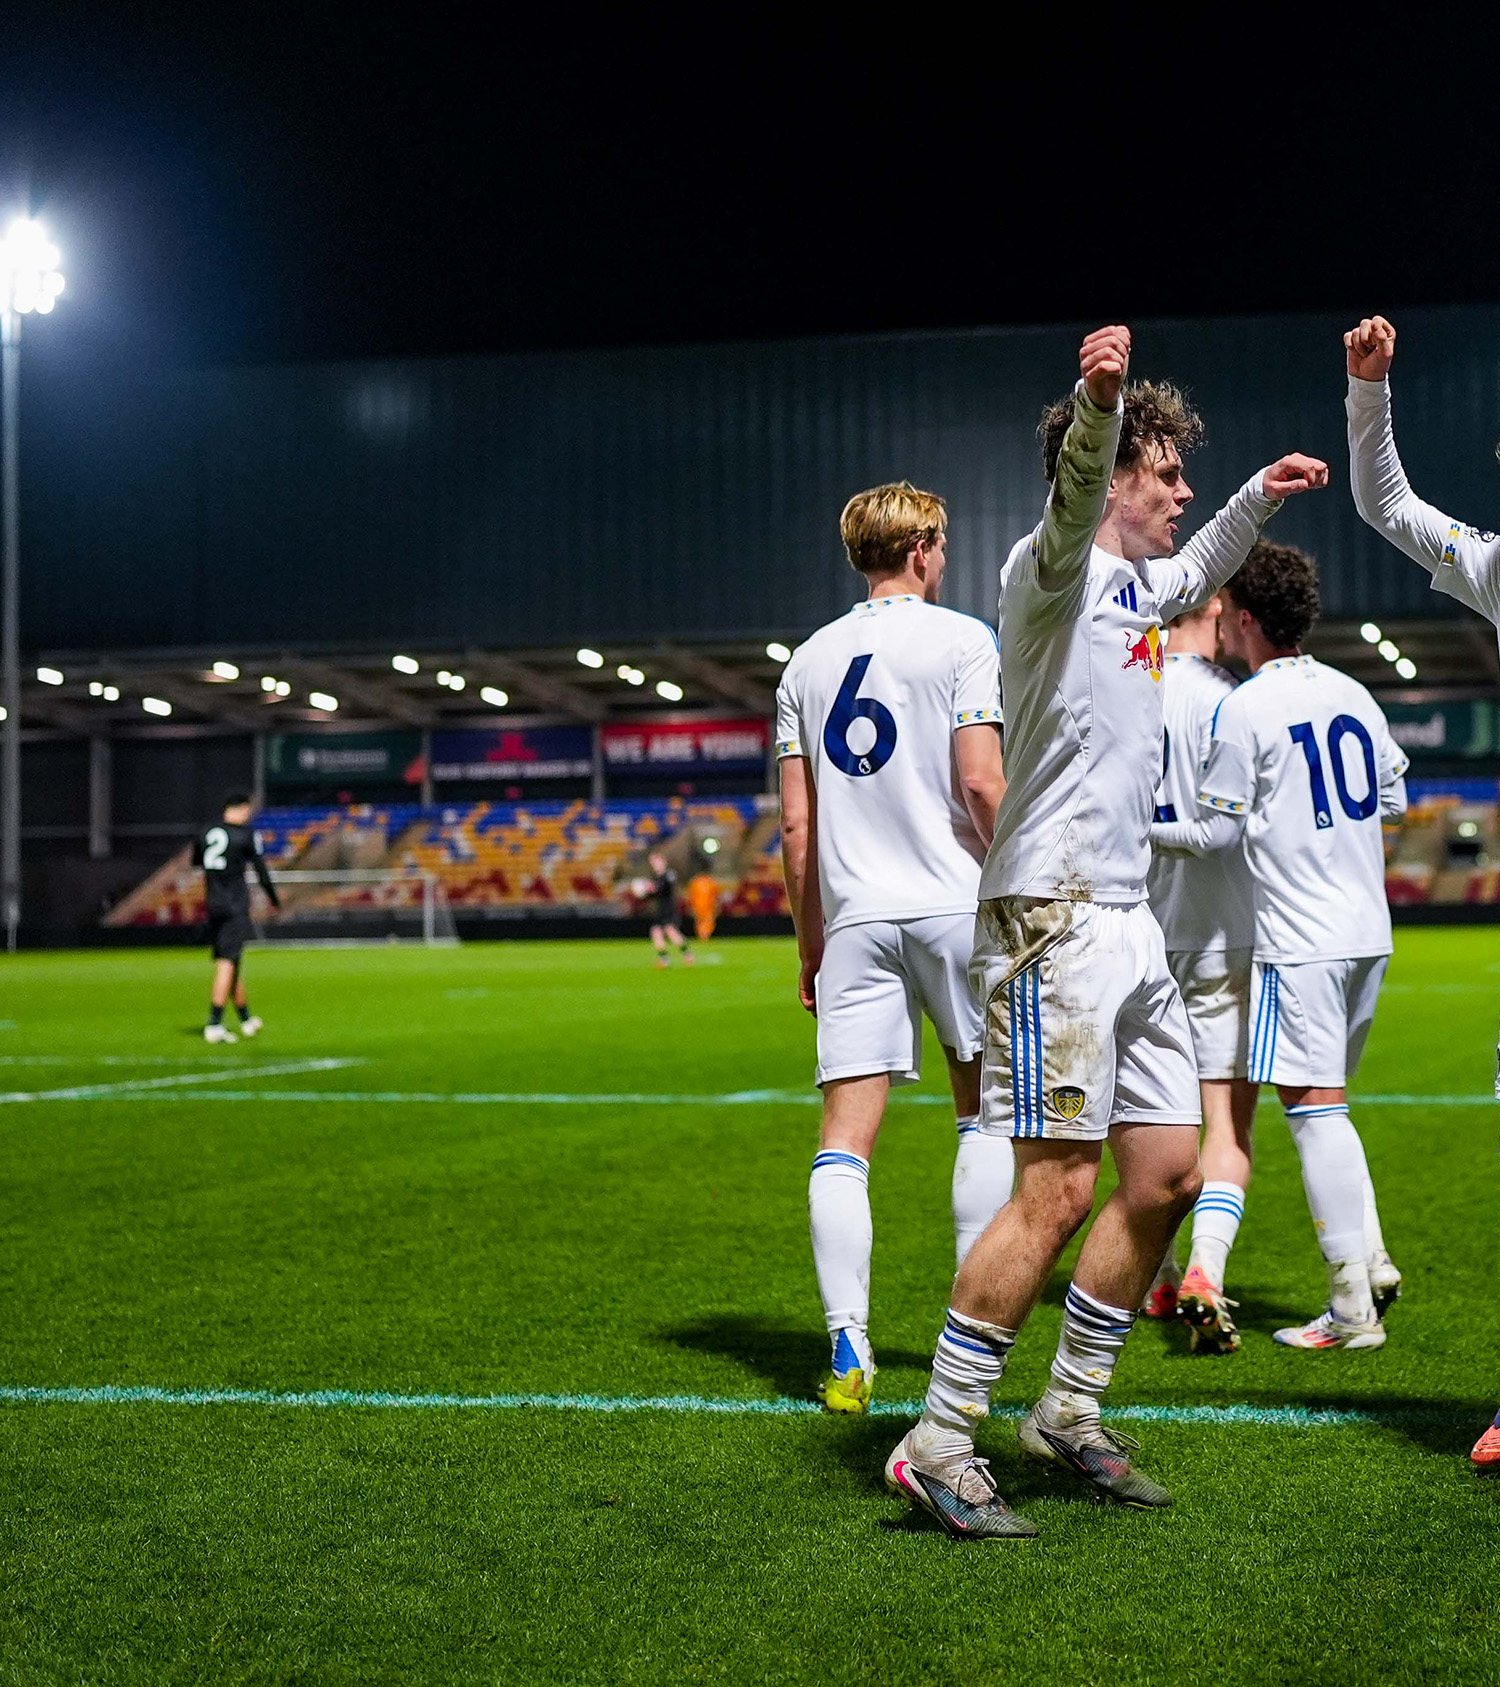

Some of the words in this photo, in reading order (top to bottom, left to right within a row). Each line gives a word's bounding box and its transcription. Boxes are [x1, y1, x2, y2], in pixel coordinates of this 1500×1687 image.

[823, 653, 897, 777] 6
[1288, 714, 1378, 830] 10
[203, 827, 229, 871] 2
